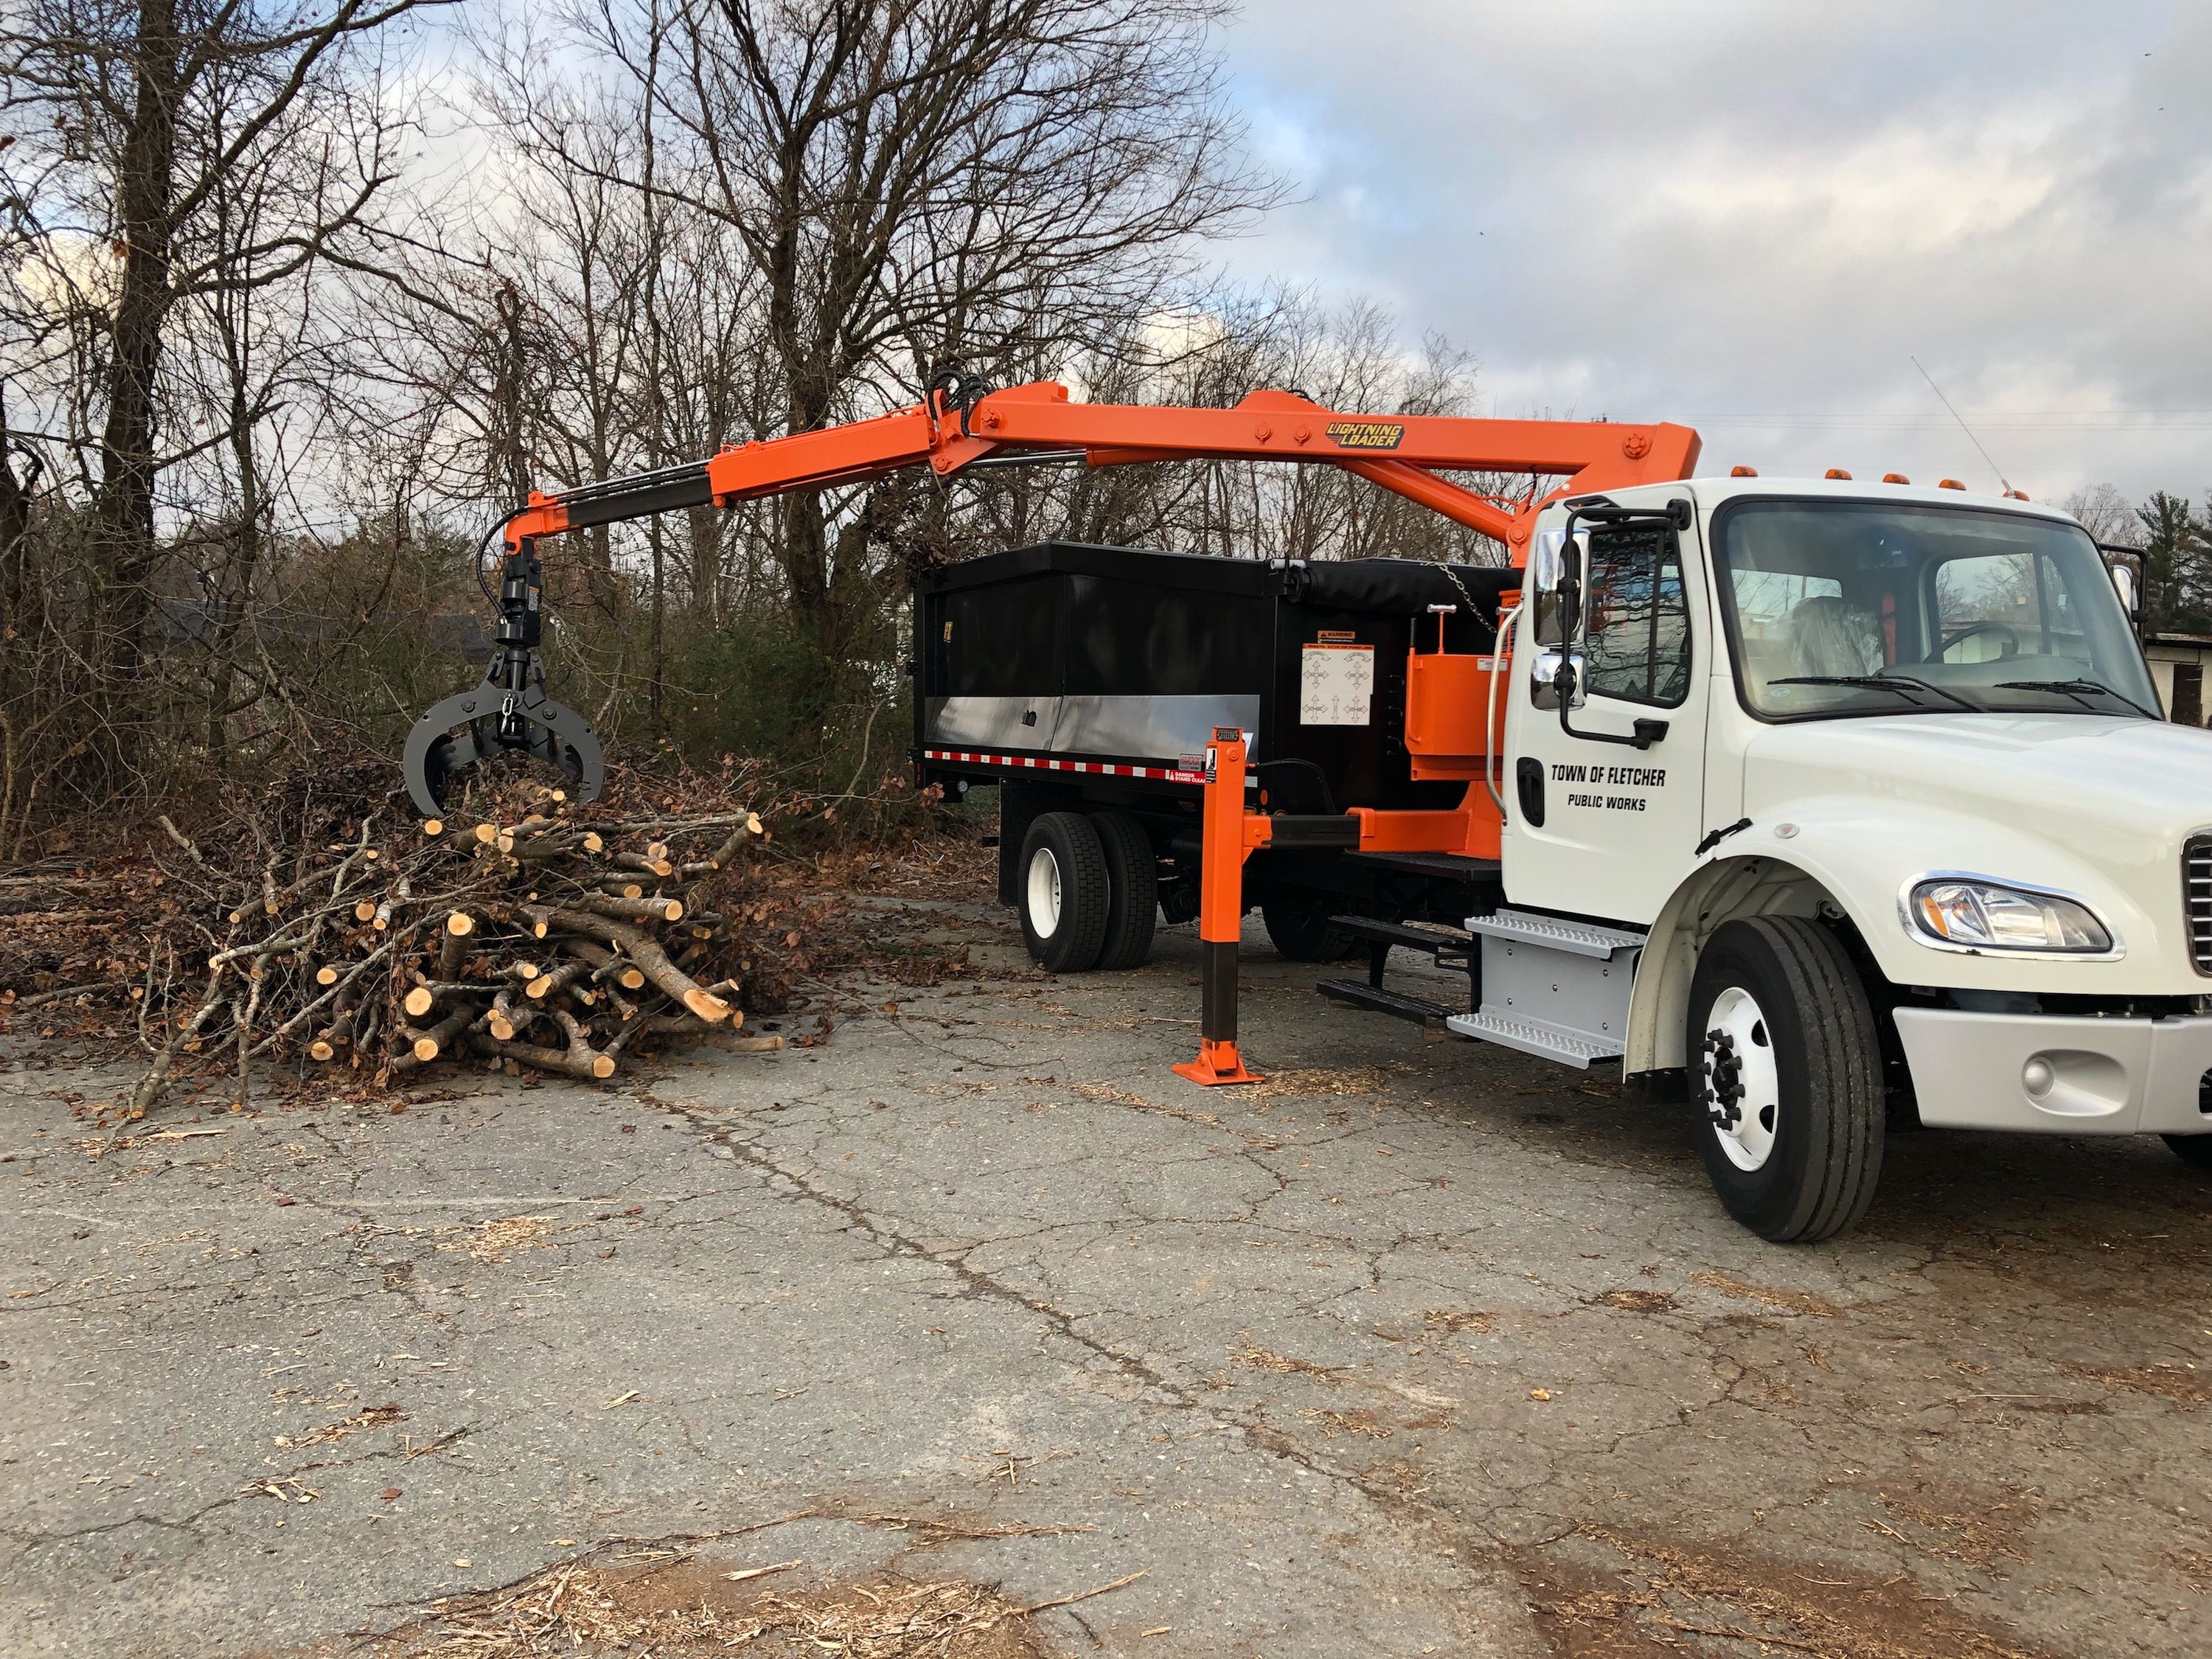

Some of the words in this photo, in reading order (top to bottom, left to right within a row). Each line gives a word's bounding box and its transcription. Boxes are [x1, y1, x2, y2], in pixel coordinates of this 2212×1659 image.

[1326, 422, 1403, 436] LIGHTNING
[1340, 435, 1398, 446] LOADER
[1180, 755, 1202, 765] HARDOX
[1551, 765, 1587, 782] TOWN
[1590, 766, 1604, 783] OF
[1607, 767, 1666, 787] FLETCHER
[1568, 794, 1603, 808] PUBLIC
[1607, 796, 1646, 811] WORKS
